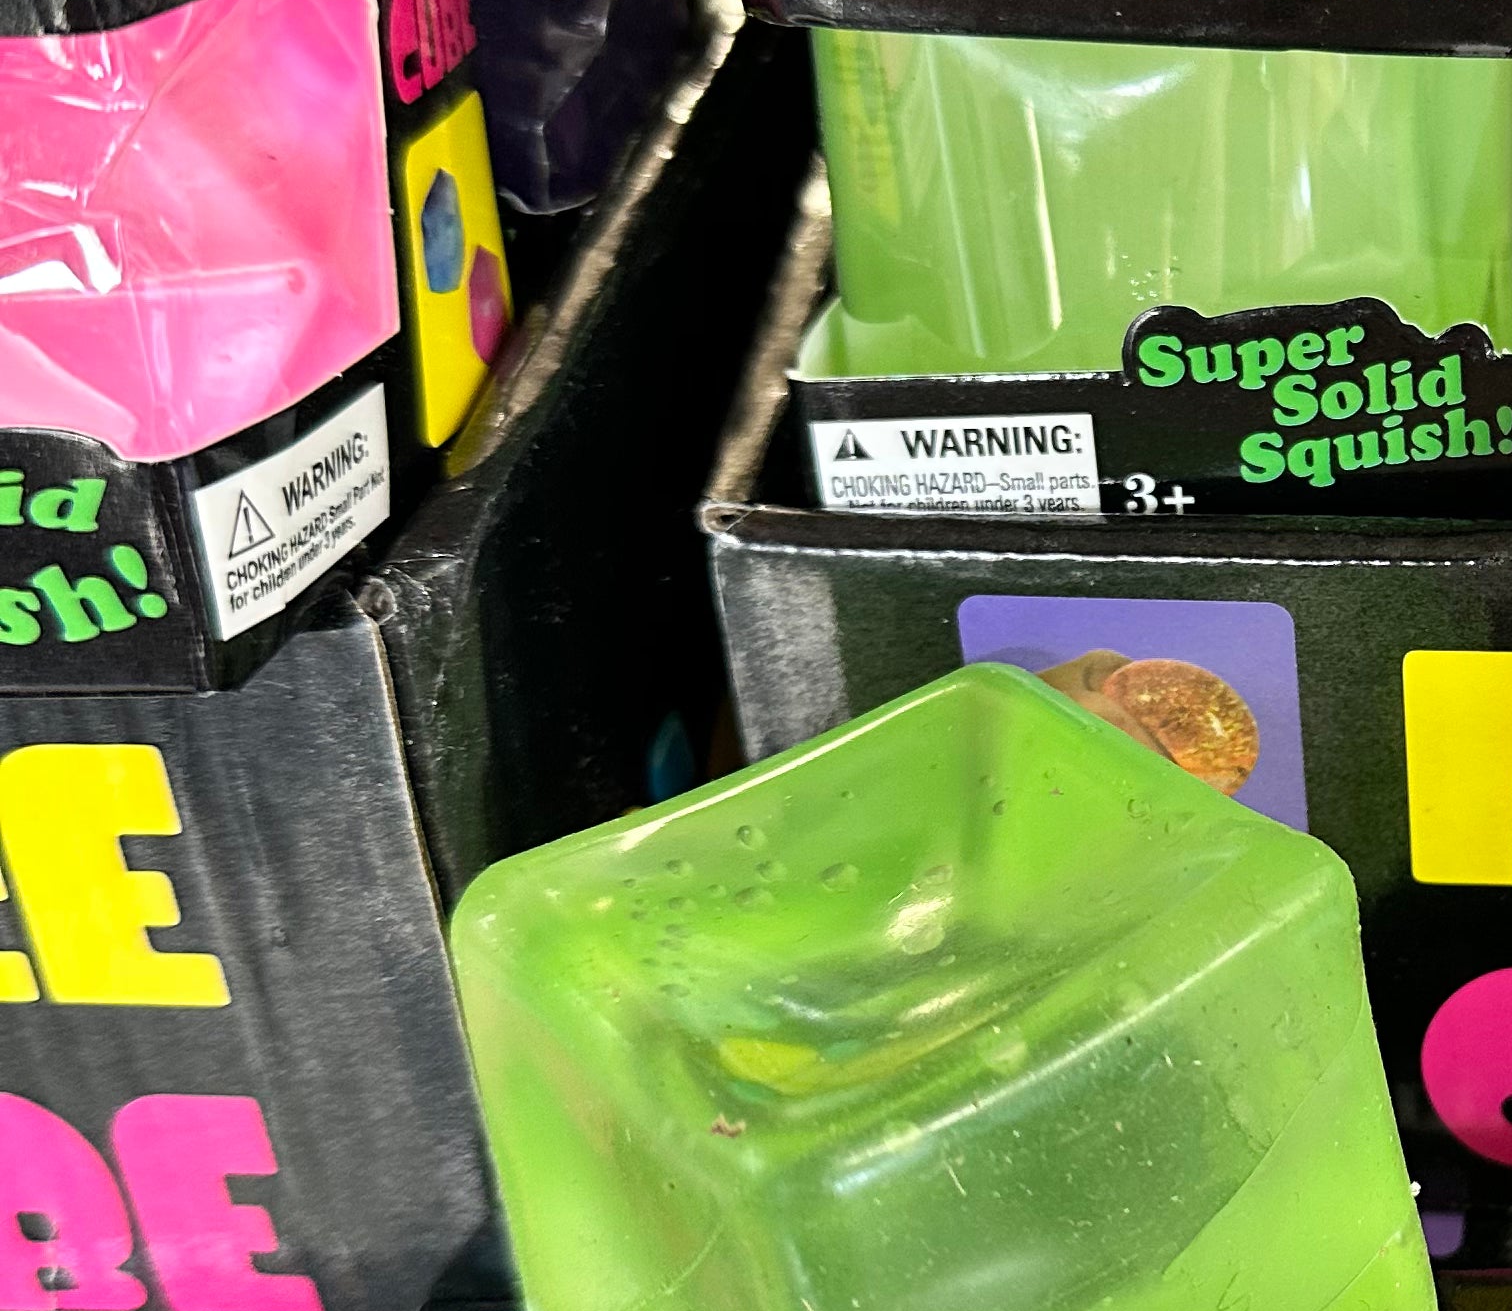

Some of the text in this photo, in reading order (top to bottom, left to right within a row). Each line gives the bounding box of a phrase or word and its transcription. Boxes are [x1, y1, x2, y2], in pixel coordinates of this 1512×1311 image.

[1136, 322, 1366, 392] Super
[1271, 354, 1467, 429] Solid
[900, 424, 1084, 460] WARNING:
[281, 431, 371, 518] WARNING:
[831, 474, 911, 499] CHOKING
[1049, 471, 1096, 493] parts.
[1023, 494, 1035, 513] 3
[1122, 472, 1197, 515] 3+
[226, 541, 288, 592] CHOKING
[289, 510, 327, 554] HAZARD
[229, 590, 250, 615] for
[252, 564, 298, 602] children
[0, 743, 231, 1007] E
